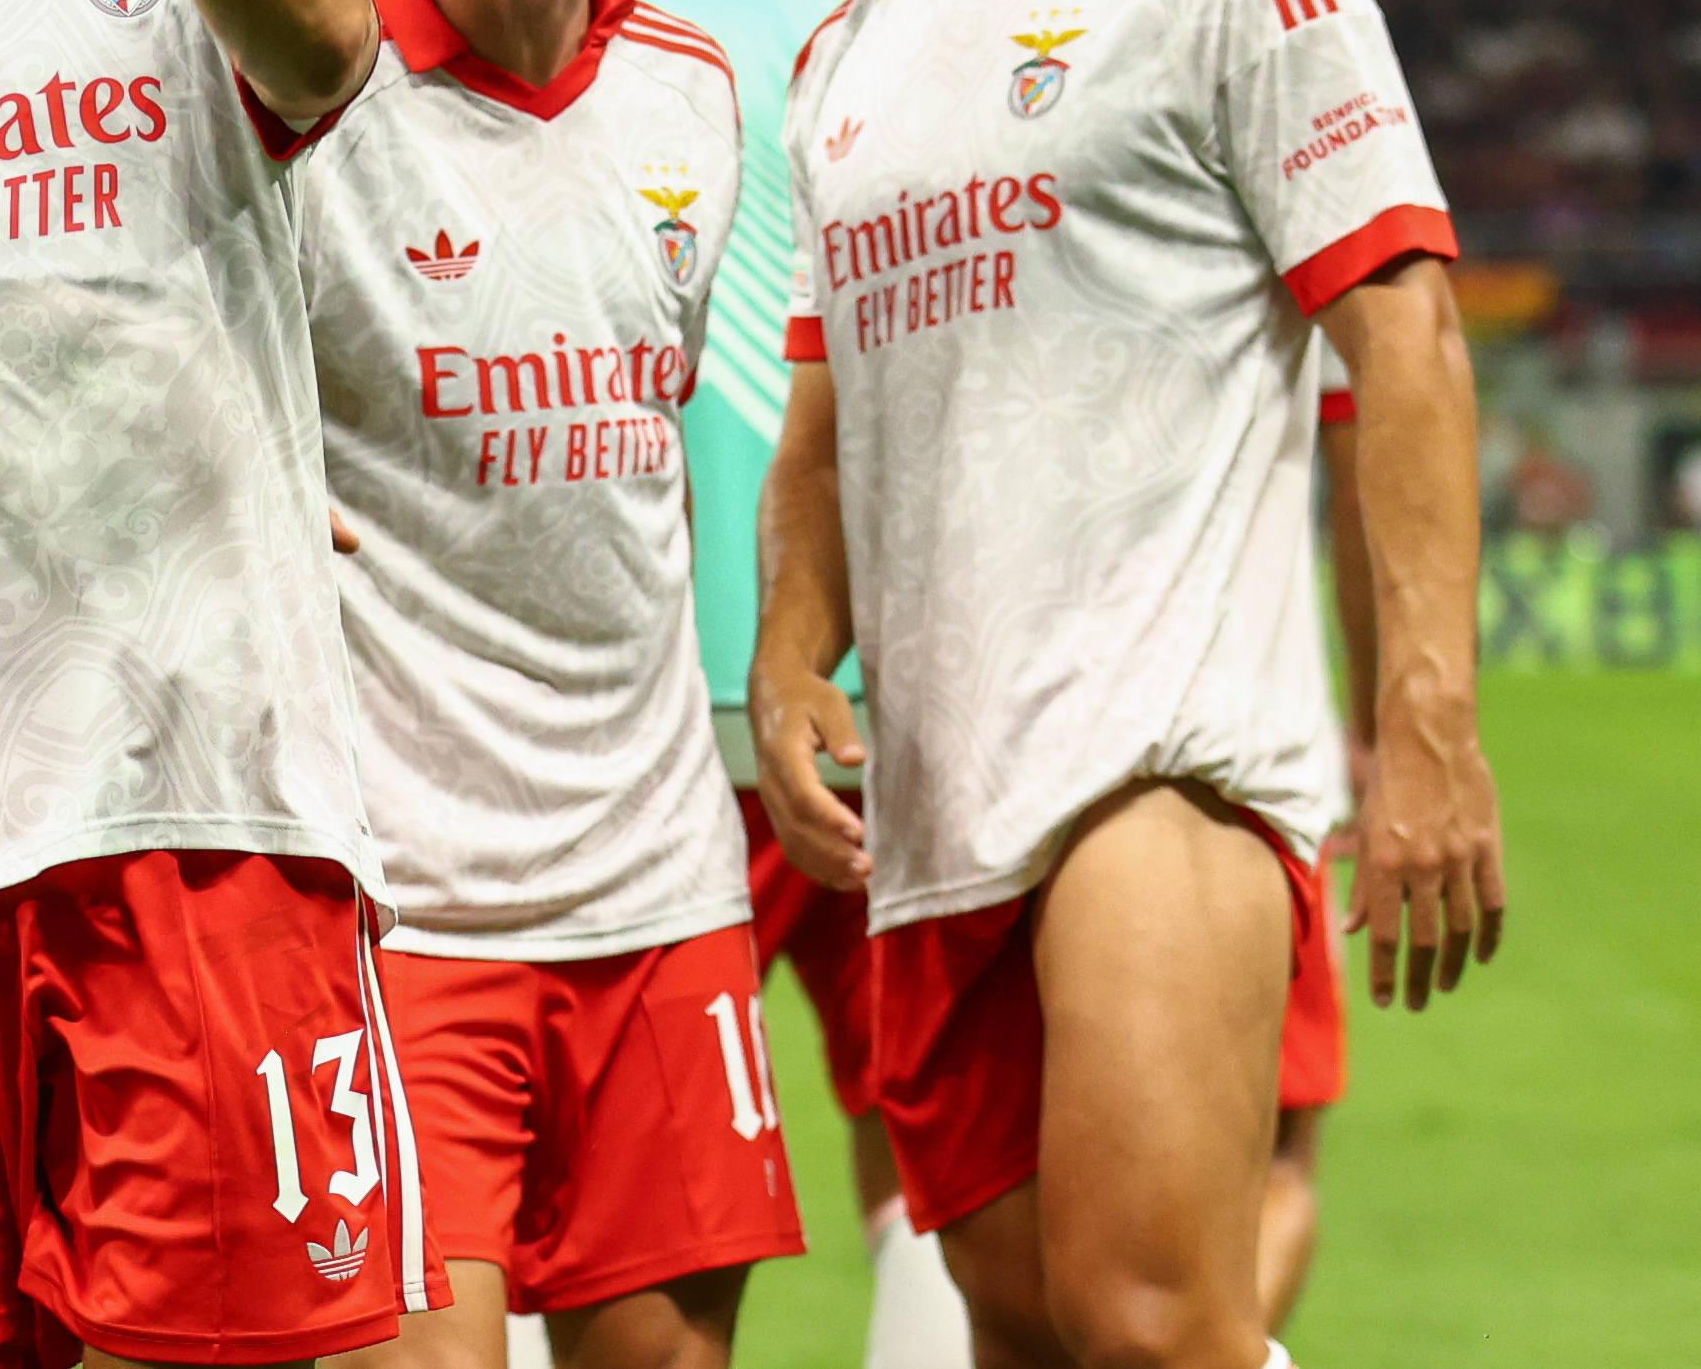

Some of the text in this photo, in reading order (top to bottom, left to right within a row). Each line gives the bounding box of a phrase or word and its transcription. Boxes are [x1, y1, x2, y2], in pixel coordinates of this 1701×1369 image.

[822, 171, 1062, 293] Emirates
[855, 250, 1016, 354] FLY BETTER
[476, 416, 668, 487] FLY BETTER
[256, 1028, 380, 1224] 13
